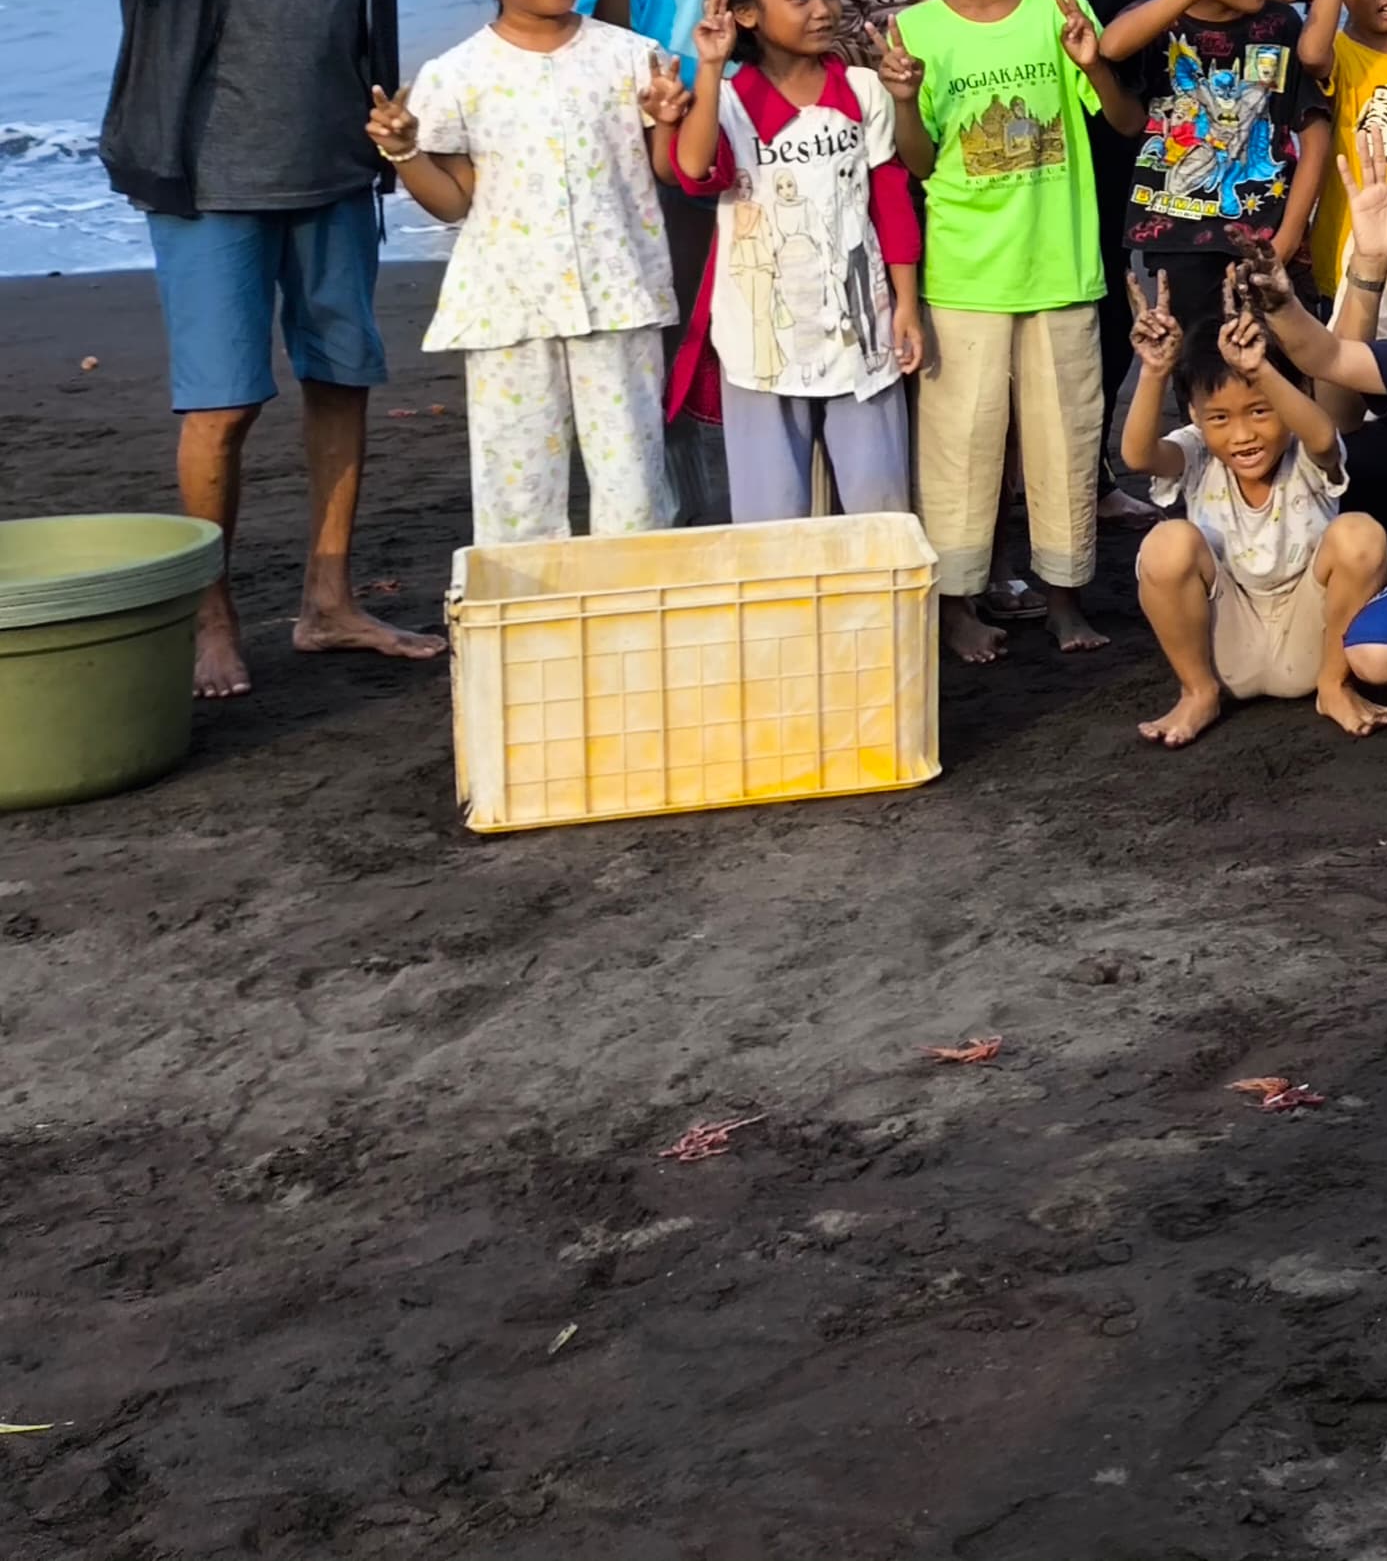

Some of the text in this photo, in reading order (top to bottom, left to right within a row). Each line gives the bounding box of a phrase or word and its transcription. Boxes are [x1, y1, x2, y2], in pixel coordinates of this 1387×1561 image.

[948, 61, 1058, 96] JOGJAKARTA
[752, 125, 858, 166] Besties
[1131, 184, 1220, 217] BTMAN
